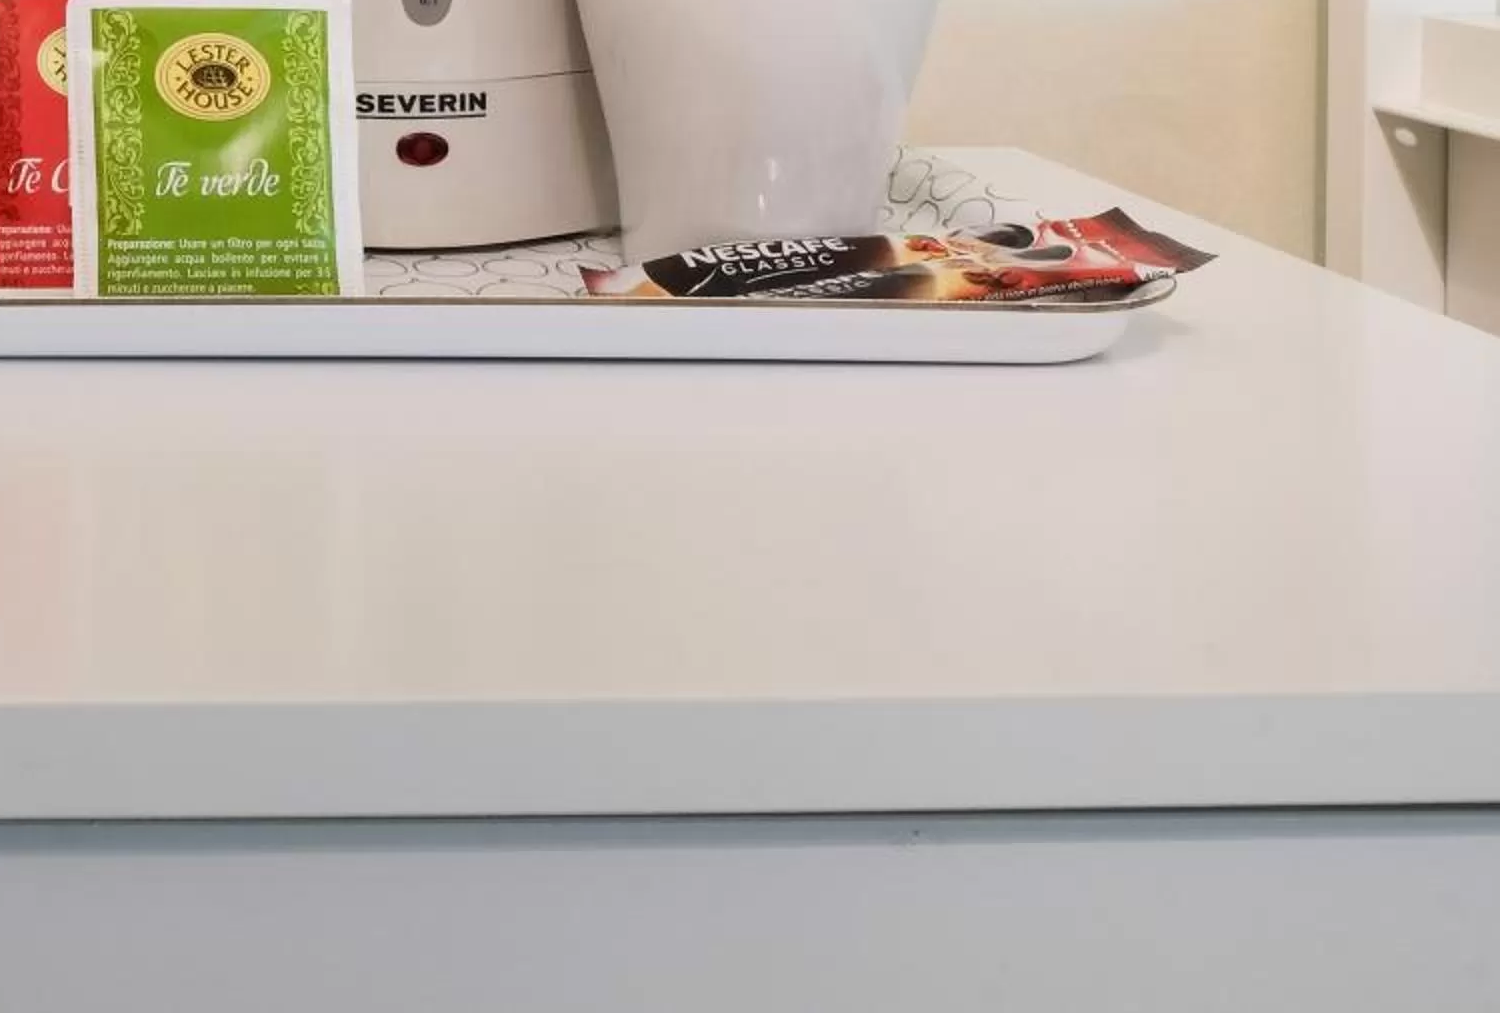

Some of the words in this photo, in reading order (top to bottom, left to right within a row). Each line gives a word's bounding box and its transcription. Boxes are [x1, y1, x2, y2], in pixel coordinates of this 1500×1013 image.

[176, 44, 251, 76] LESTER
[176, 80, 253, 109] HOUSE
[355, 92, 487, 113] SEVERIN
[200, 158, 280, 197] verde
[720, 252, 835, 276] CLASSIC
